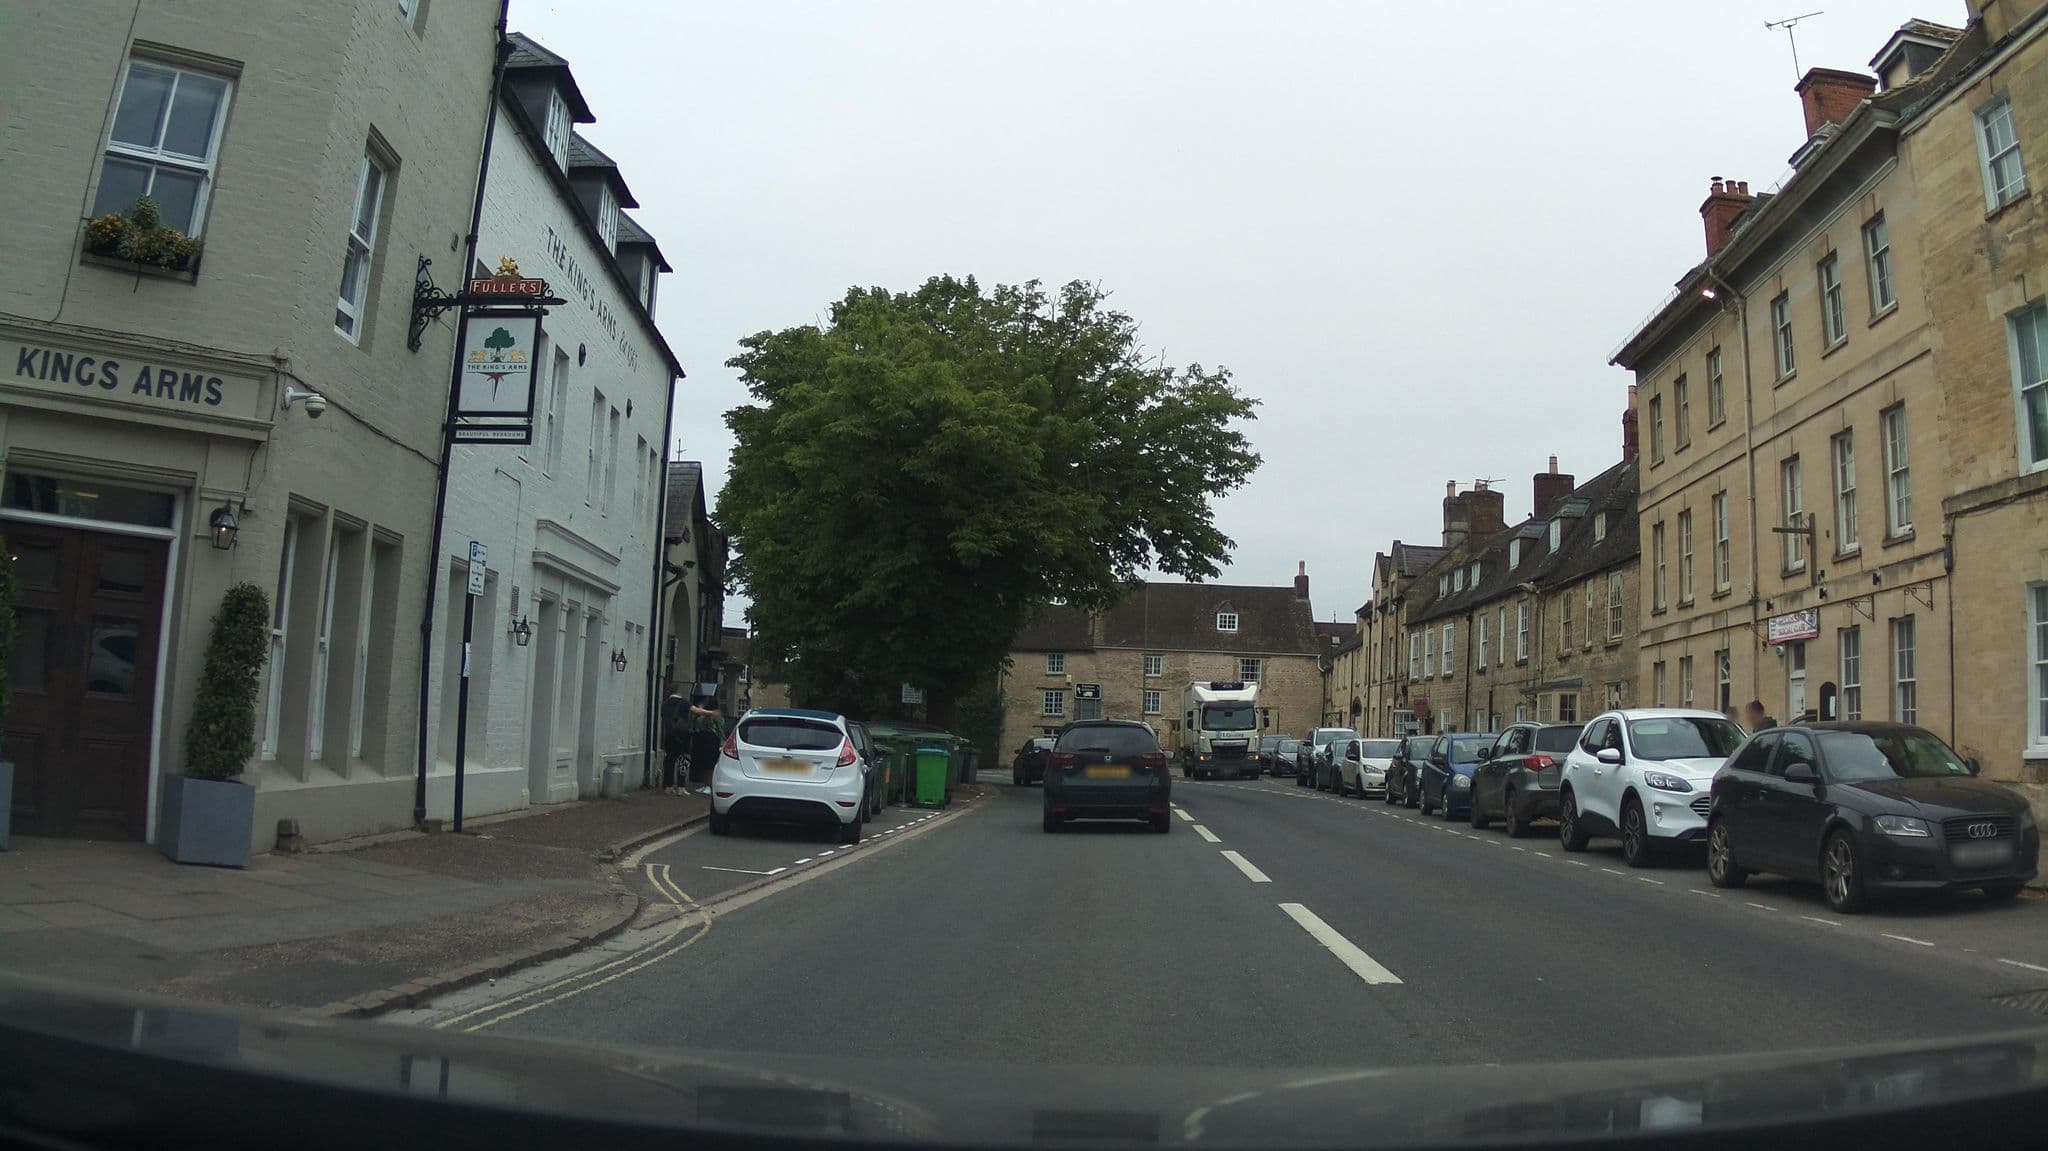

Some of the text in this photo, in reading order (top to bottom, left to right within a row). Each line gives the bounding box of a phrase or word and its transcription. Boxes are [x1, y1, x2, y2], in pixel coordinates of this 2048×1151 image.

[547, 228, 567, 271] THE
[567, 255, 596, 312] KING'S
[596, 299, 617, 341] ARMS
[15, 346, 224, 406] KINGS ARMS
